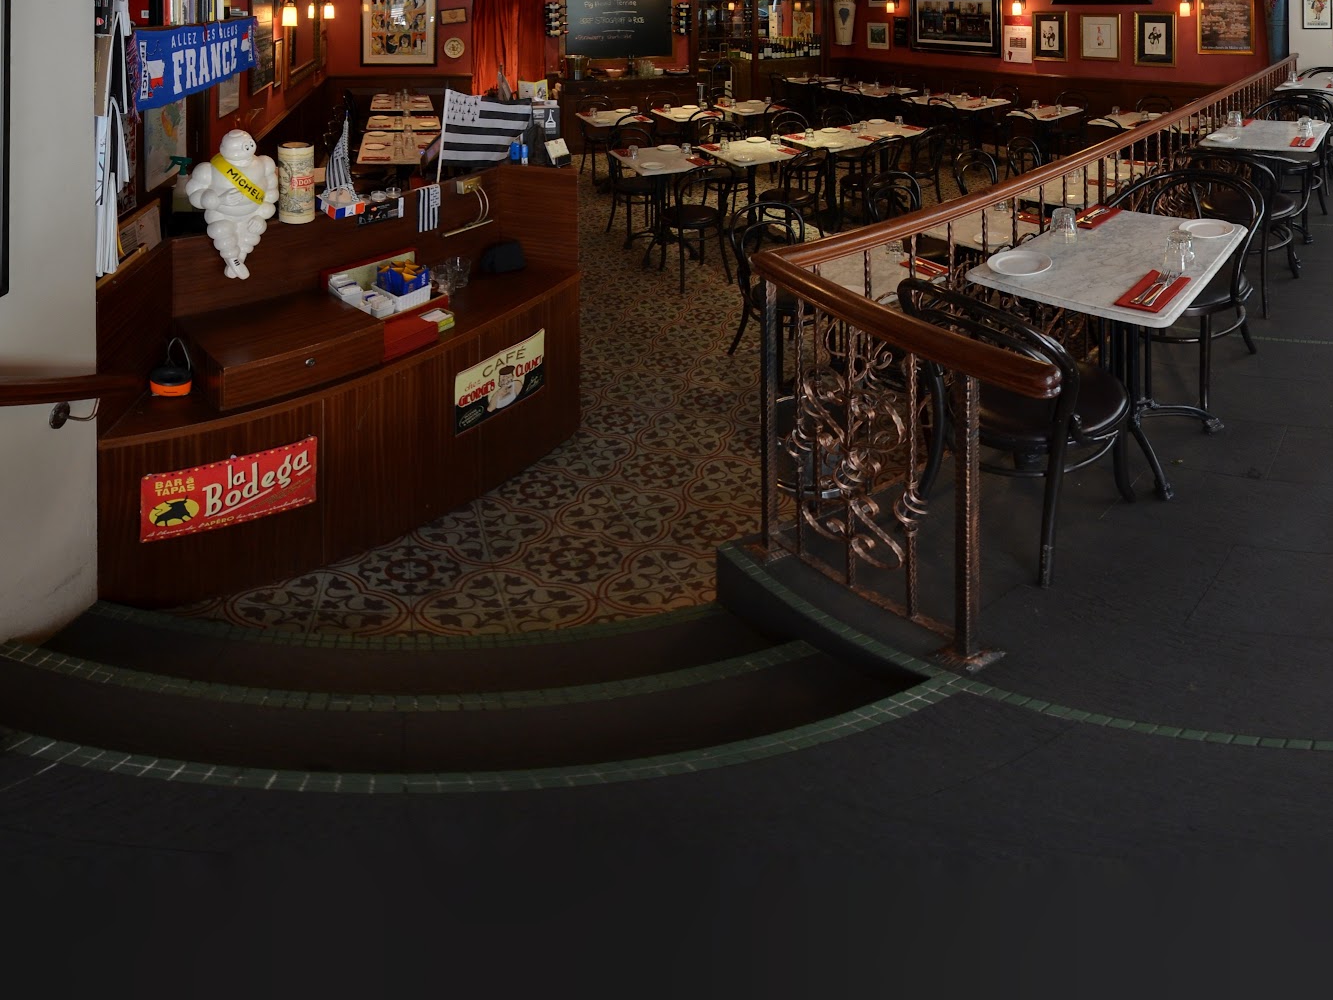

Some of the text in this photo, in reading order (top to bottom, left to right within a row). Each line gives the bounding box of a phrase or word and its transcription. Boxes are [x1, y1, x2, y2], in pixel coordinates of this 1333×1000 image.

[171, 31, 197, 48] ALLEZ
[218, 25, 238, 39] BLEUS
[139, 41, 148, 100] FRANCE
[172, 38, 238, 95] FRANCE
[227, 168, 264, 202] MICHEL
[482, 346, 526, 378] CAFÉ
[458, 379, 496, 407] GEORGES
[155, 478, 183, 491] BAR
[155, 483, 195, 497] TAPAS
[202, 449, 310, 518] Bodega
[227, 464, 246, 490] la
